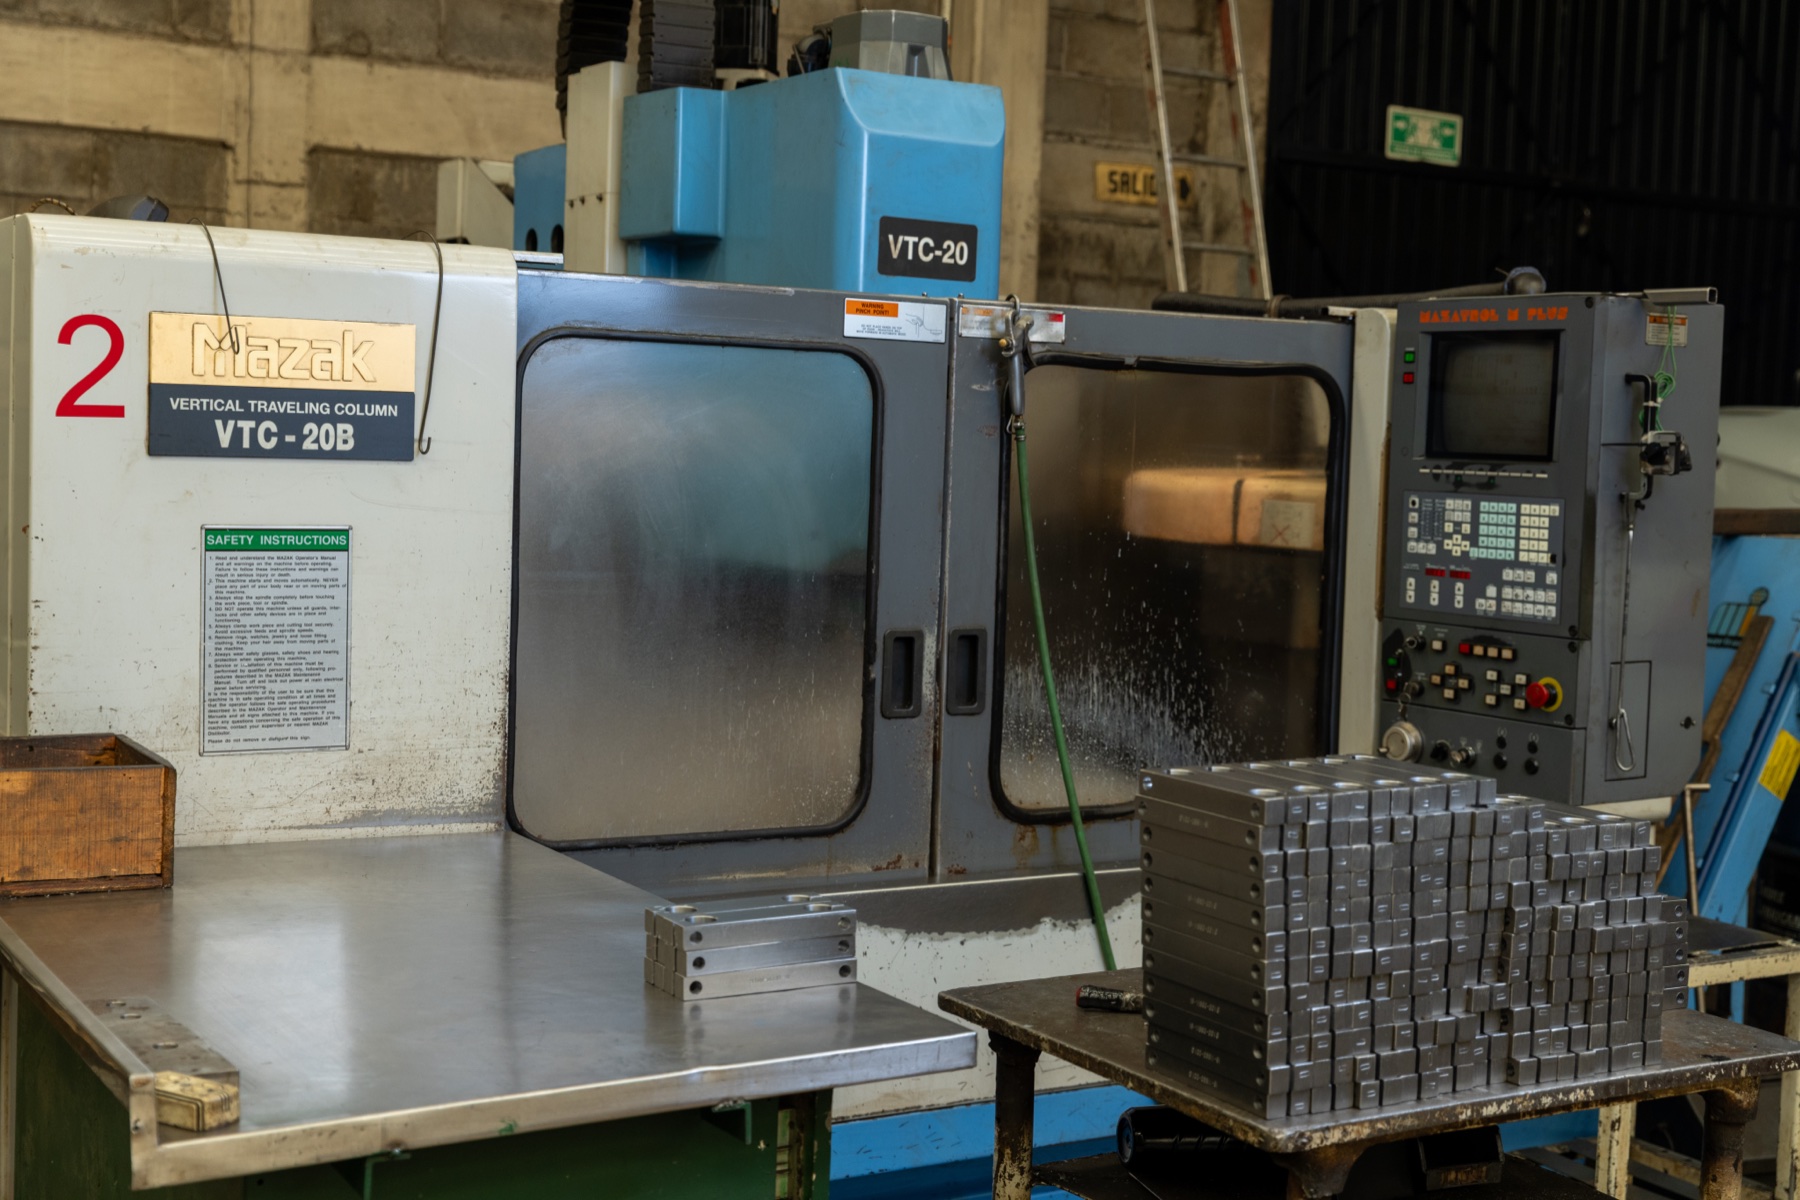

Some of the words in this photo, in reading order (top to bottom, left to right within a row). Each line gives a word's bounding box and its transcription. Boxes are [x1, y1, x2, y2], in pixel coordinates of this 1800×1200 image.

[1108, 170, 1158, 195] SALID
[887, 234, 969, 266] VTC-20
[1507, 308, 1519, 321] M
[1527, 306, 1568, 320] PLUS
[192, 322, 378, 383] Mazak
[56, 314, 126, 418] 2
[170, 397, 244, 413] VERTICAL
[248, 400, 330, 415] TRAVELING
[334, 402, 398, 418] COLUMN
[207, 534, 254, 545] SAFETY
[260, 535, 347, 546] INSTRUCTIONS
